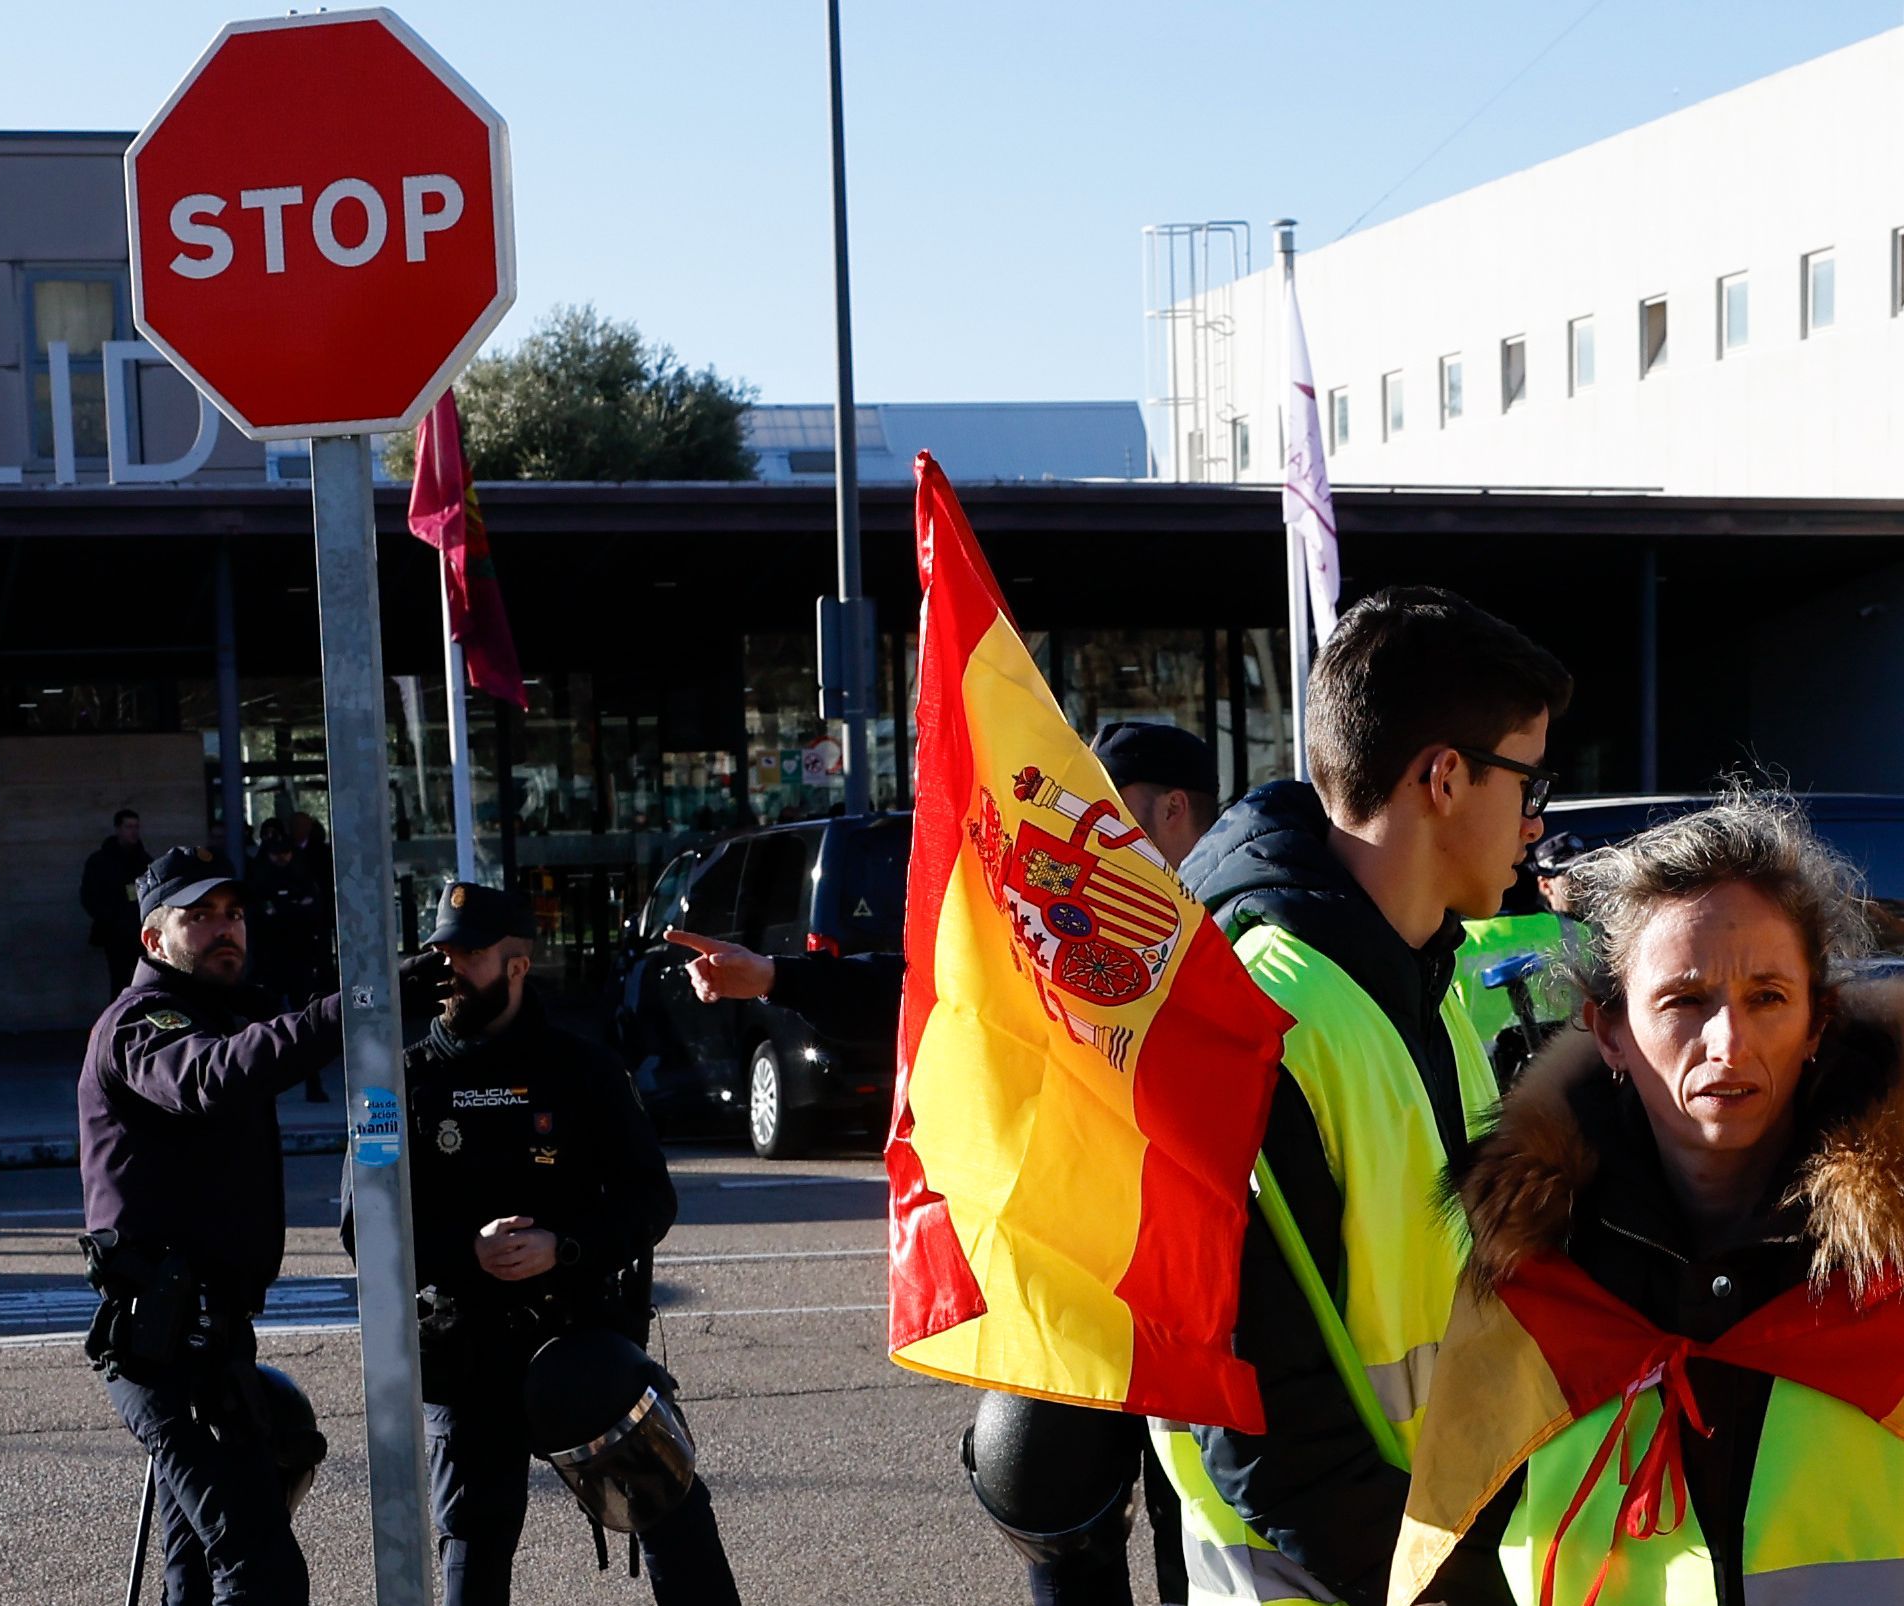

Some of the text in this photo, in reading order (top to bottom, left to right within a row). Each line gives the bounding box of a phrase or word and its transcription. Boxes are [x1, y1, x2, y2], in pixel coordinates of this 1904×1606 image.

[169, 174, 464, 280] STOP
[452, 1087, 513, 1100] POLICIA
[452, 1095, 530, 1108] NACIONAL
